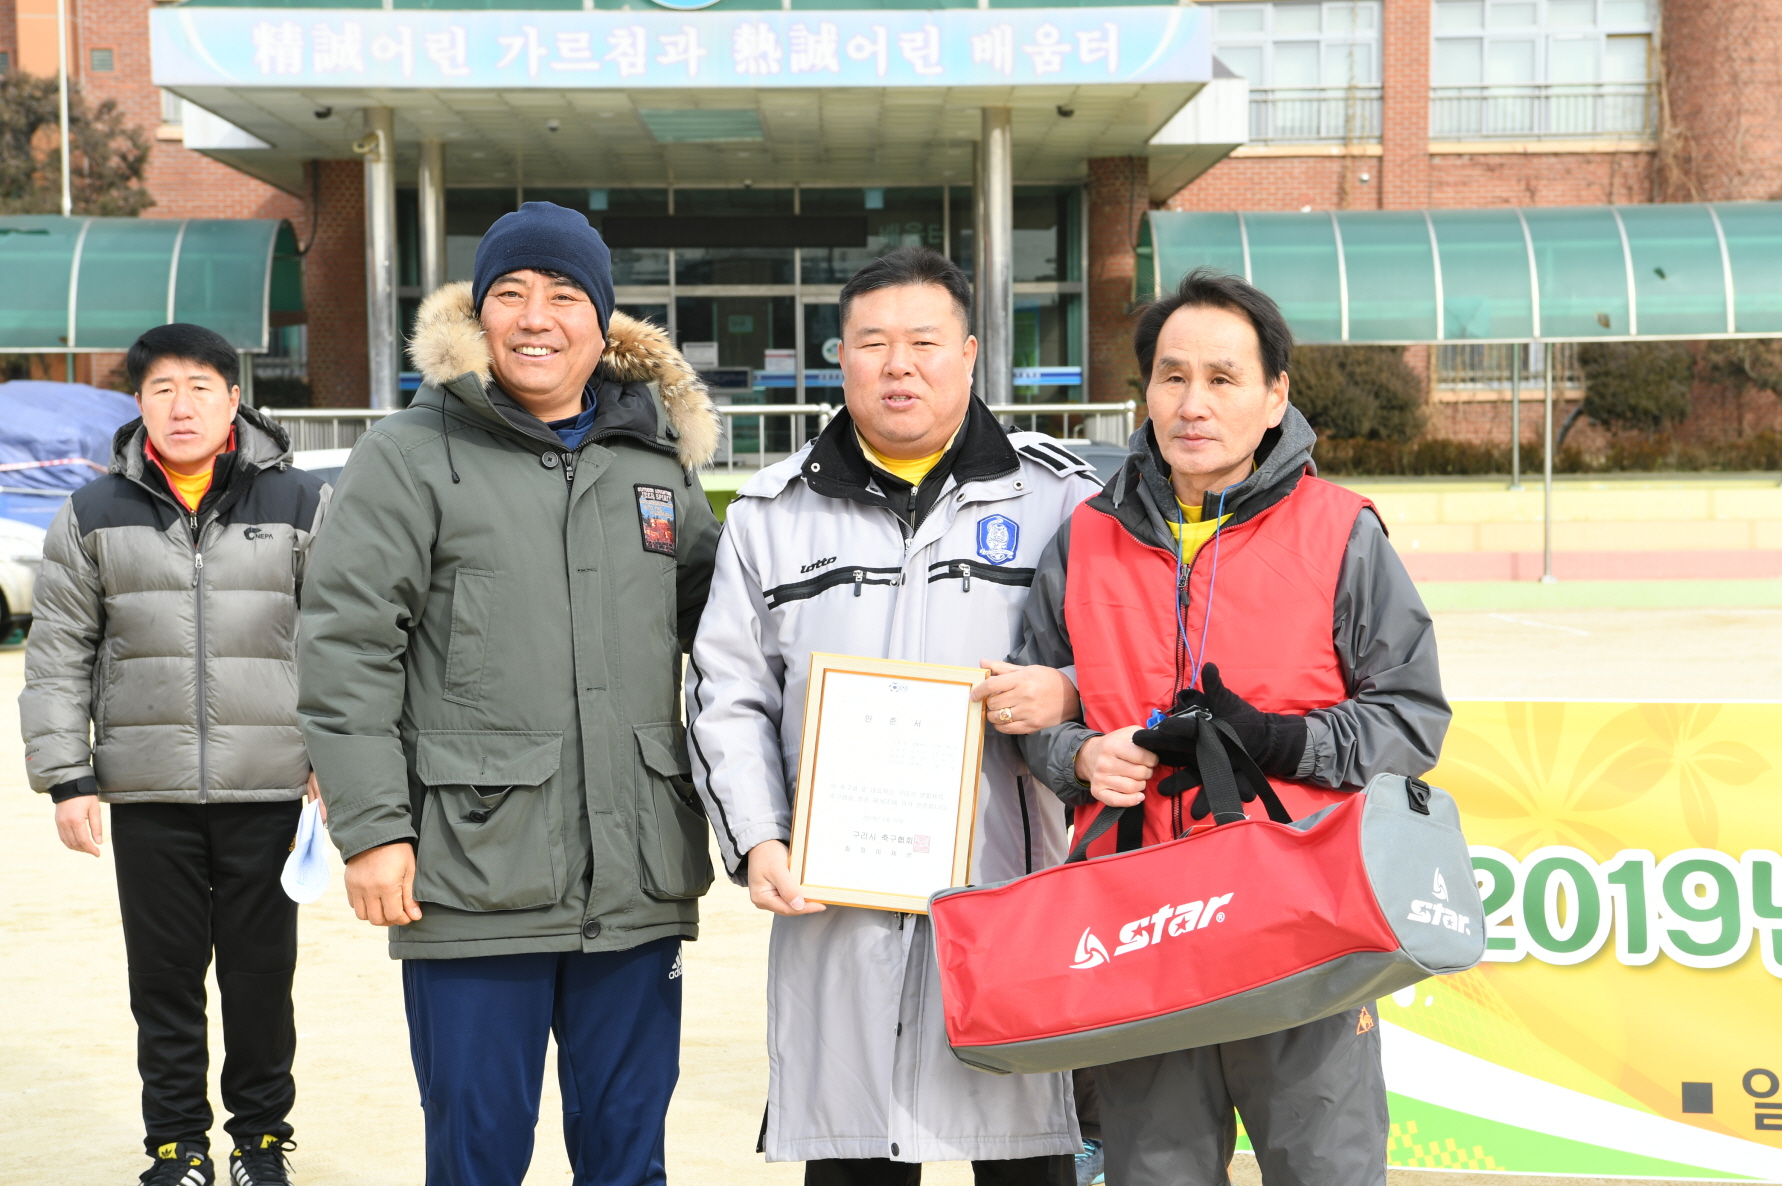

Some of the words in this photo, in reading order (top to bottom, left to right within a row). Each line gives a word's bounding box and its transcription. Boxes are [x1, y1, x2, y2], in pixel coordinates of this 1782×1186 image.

[251, 22, 472, 80] 精誠어린
[495, 24, 708, 80] 가르침과
[732, 22, 946, 80] 熱誠어린
[970, 22, 1121, 78] 배움터
[852, 830, 877, 841] 구리시
[881, 833, 913, 845] 축구협회
